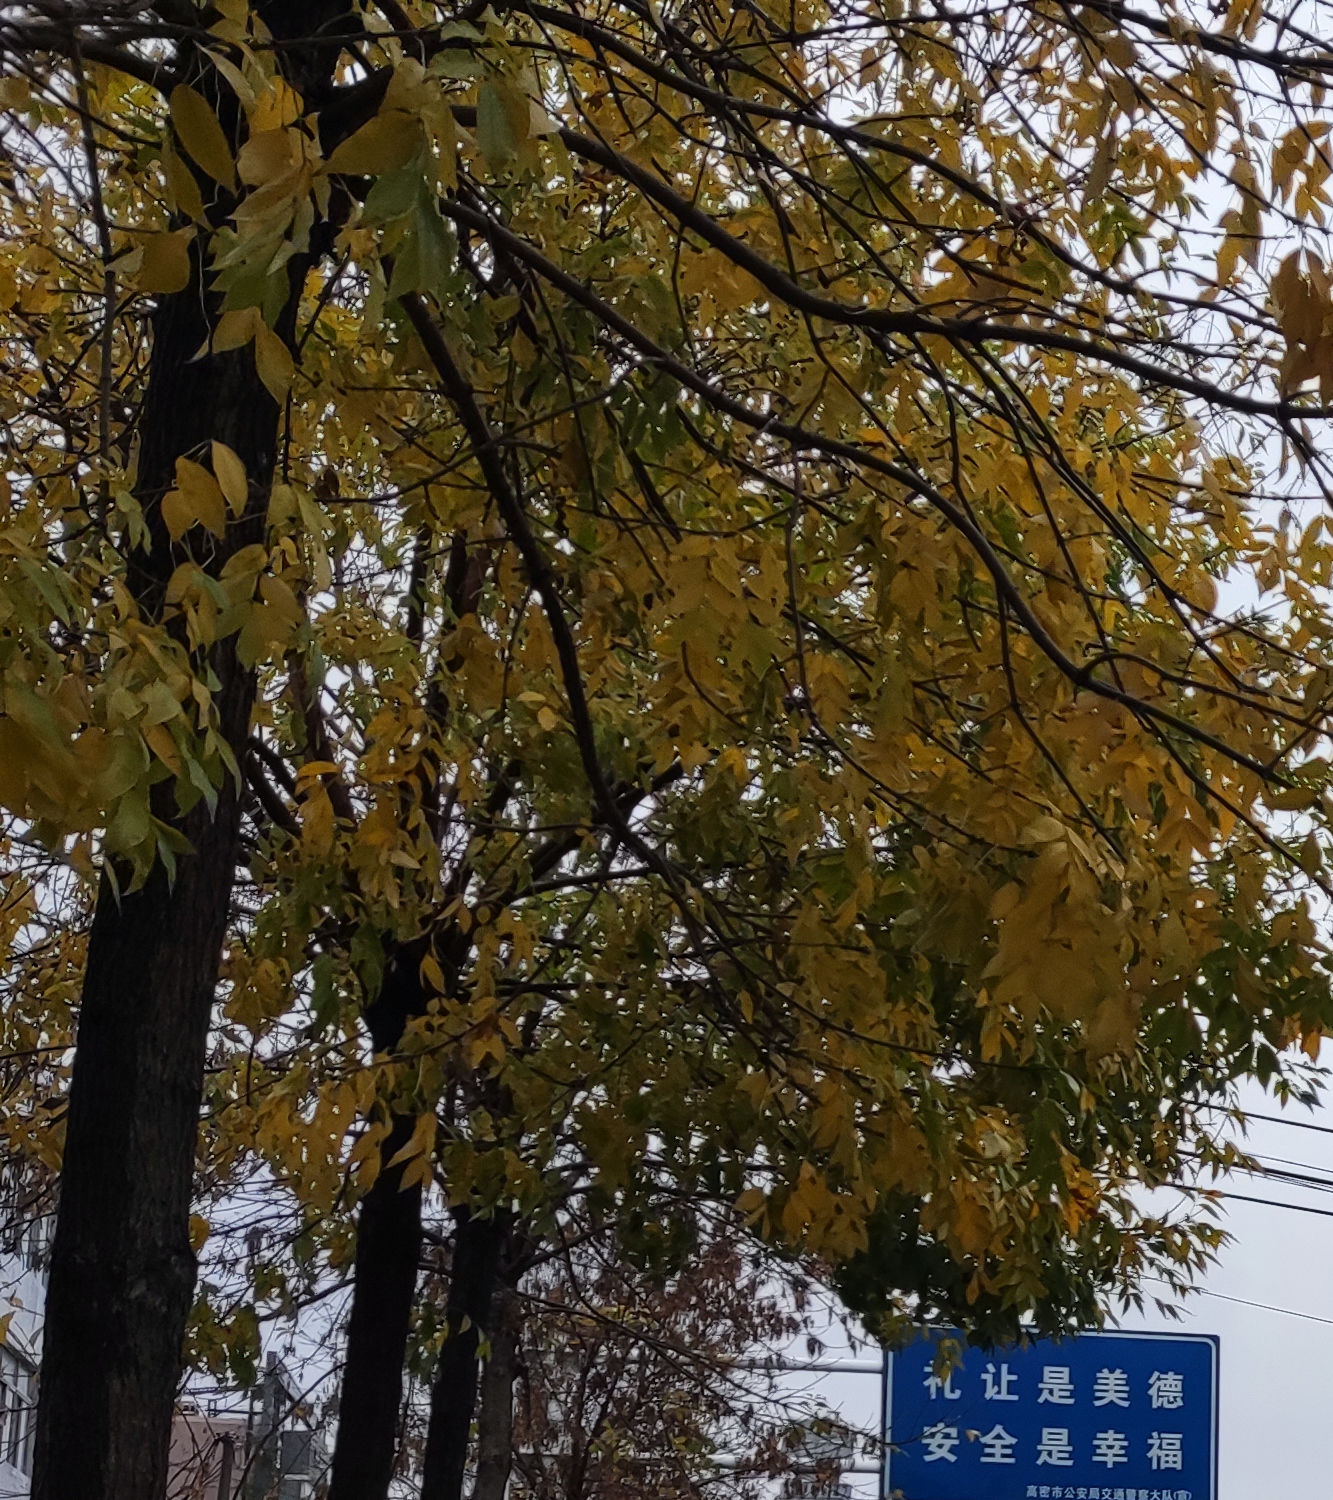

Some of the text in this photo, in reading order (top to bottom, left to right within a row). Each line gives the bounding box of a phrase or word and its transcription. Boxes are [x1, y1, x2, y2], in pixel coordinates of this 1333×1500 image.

[922, 1360, 1185, 1410] 礼让是美德
[921, 1422, 1184, 1471] 安全是幸福
